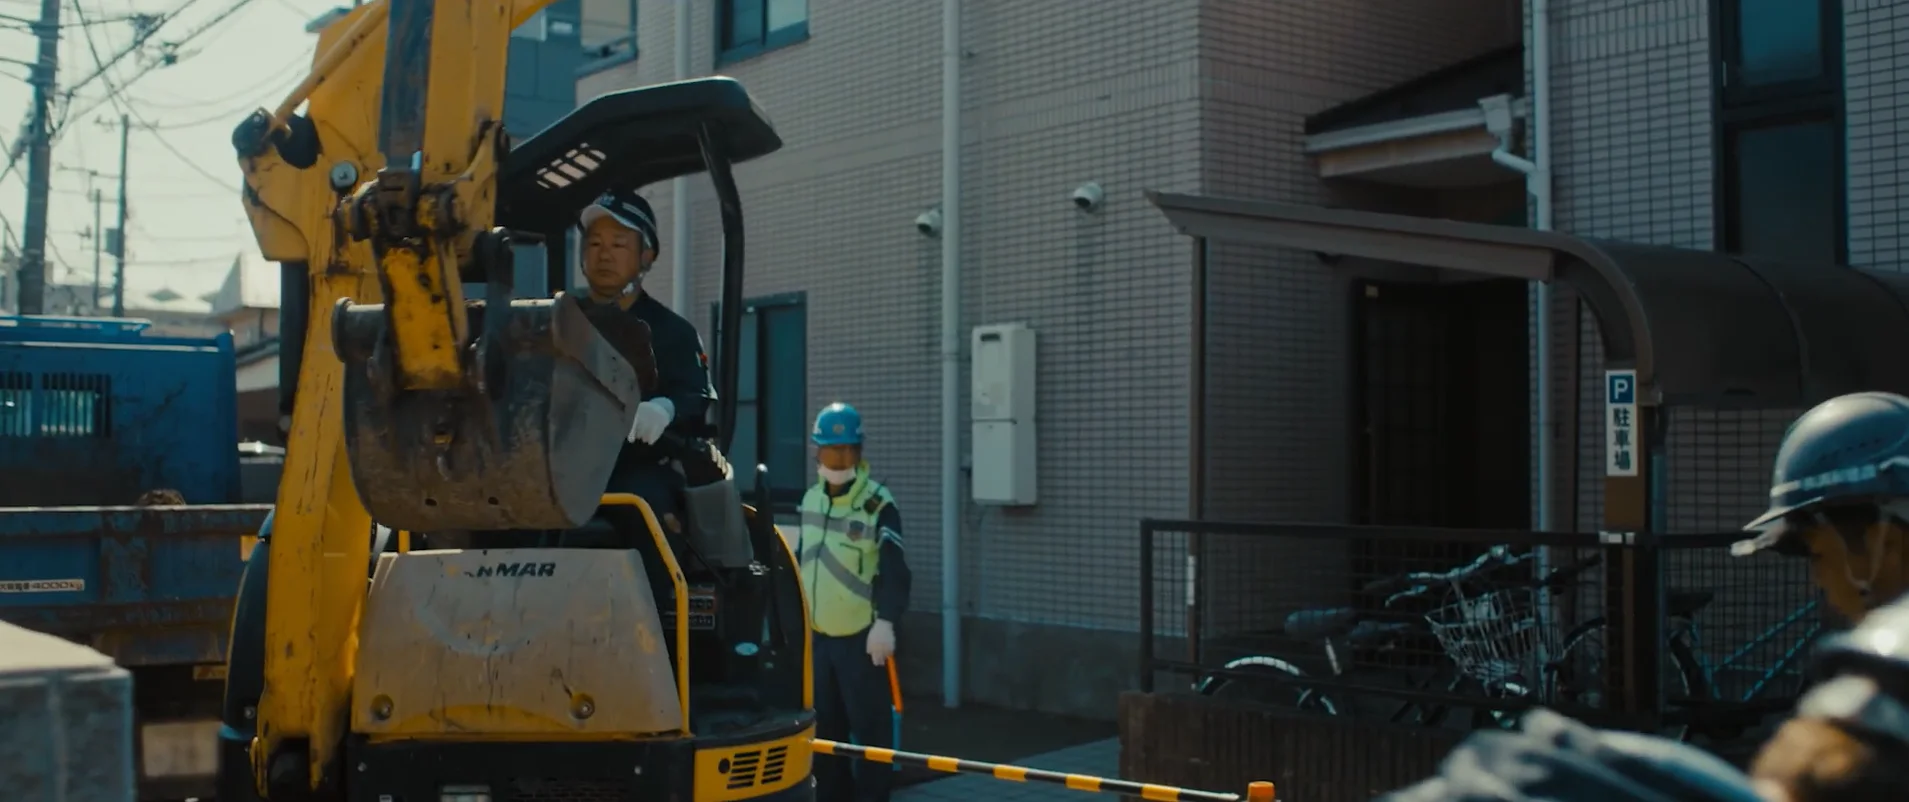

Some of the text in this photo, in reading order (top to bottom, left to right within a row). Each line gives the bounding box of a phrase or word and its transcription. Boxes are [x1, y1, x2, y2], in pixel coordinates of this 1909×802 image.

[1614, 378, 1629, 400] P
[1613, 407, 1631, 471] 駐車場
[464, 562, 556, 578] NMAR
